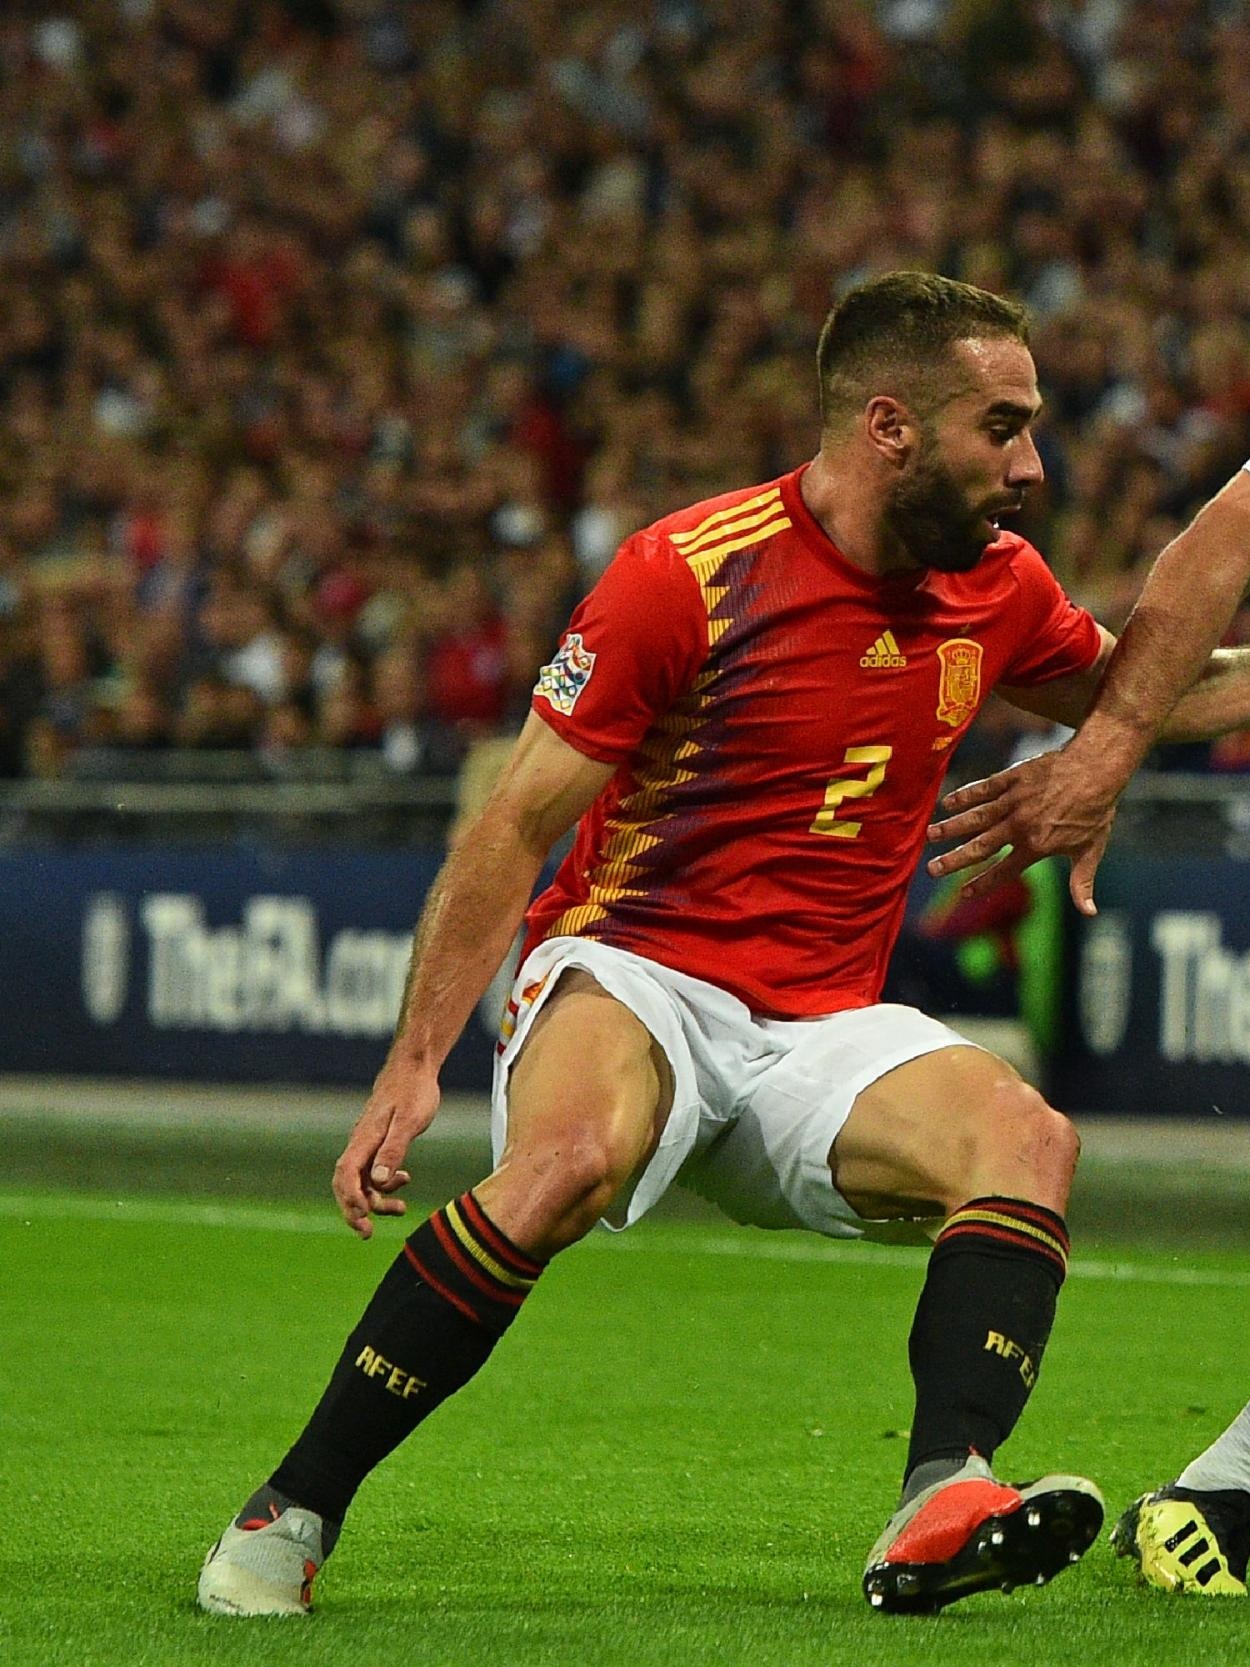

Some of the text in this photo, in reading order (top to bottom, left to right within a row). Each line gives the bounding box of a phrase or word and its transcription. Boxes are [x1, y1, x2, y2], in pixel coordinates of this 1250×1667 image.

[859, 654, 907, 668] adidas
[808, 745, 893, 839] 2
[355, 1345, 427, 1399] AFEF
